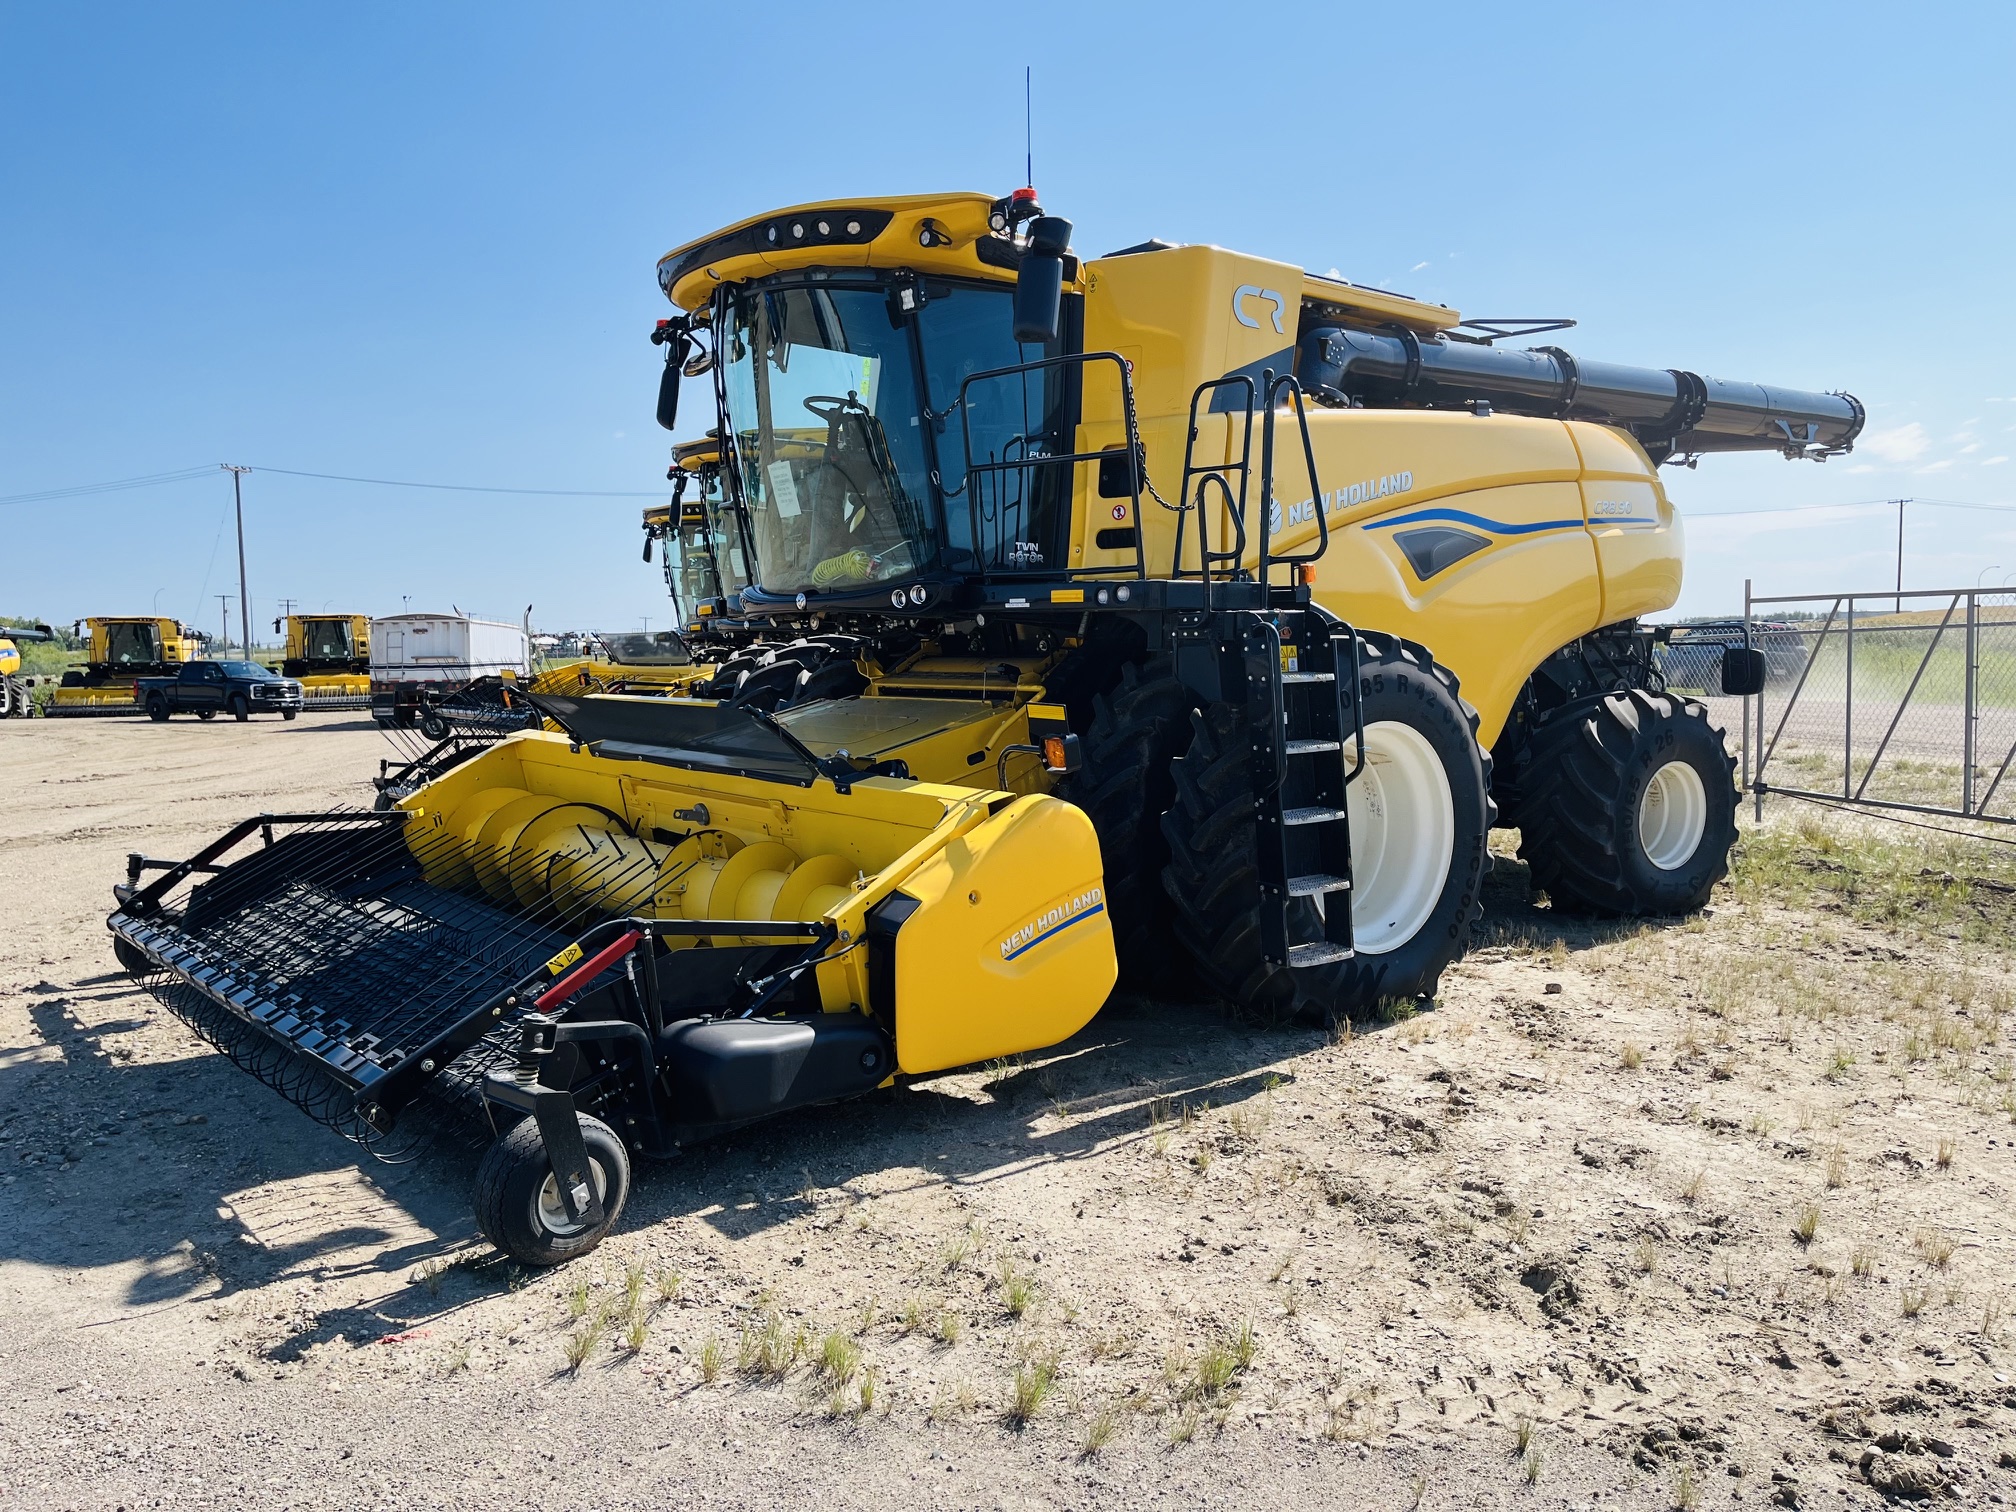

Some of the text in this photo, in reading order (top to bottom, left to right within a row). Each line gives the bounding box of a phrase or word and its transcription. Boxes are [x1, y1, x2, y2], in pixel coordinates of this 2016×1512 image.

[1232, 283, 1285, 334] CR
[1028, 451, 1051, 459] PLM
[1335, 470, 1414, 511] HOLLAND
[1008, 551, 1044, 564] ROTOR
[1015, 541, 1039, 552] TWIN
[1396, 673, 1409, 695] R
[1414, 681, 1438, 709] 42
[1655, 728, 1675, 755] 26
[1000, 887, 1103, 958] NEW HOLLAND
